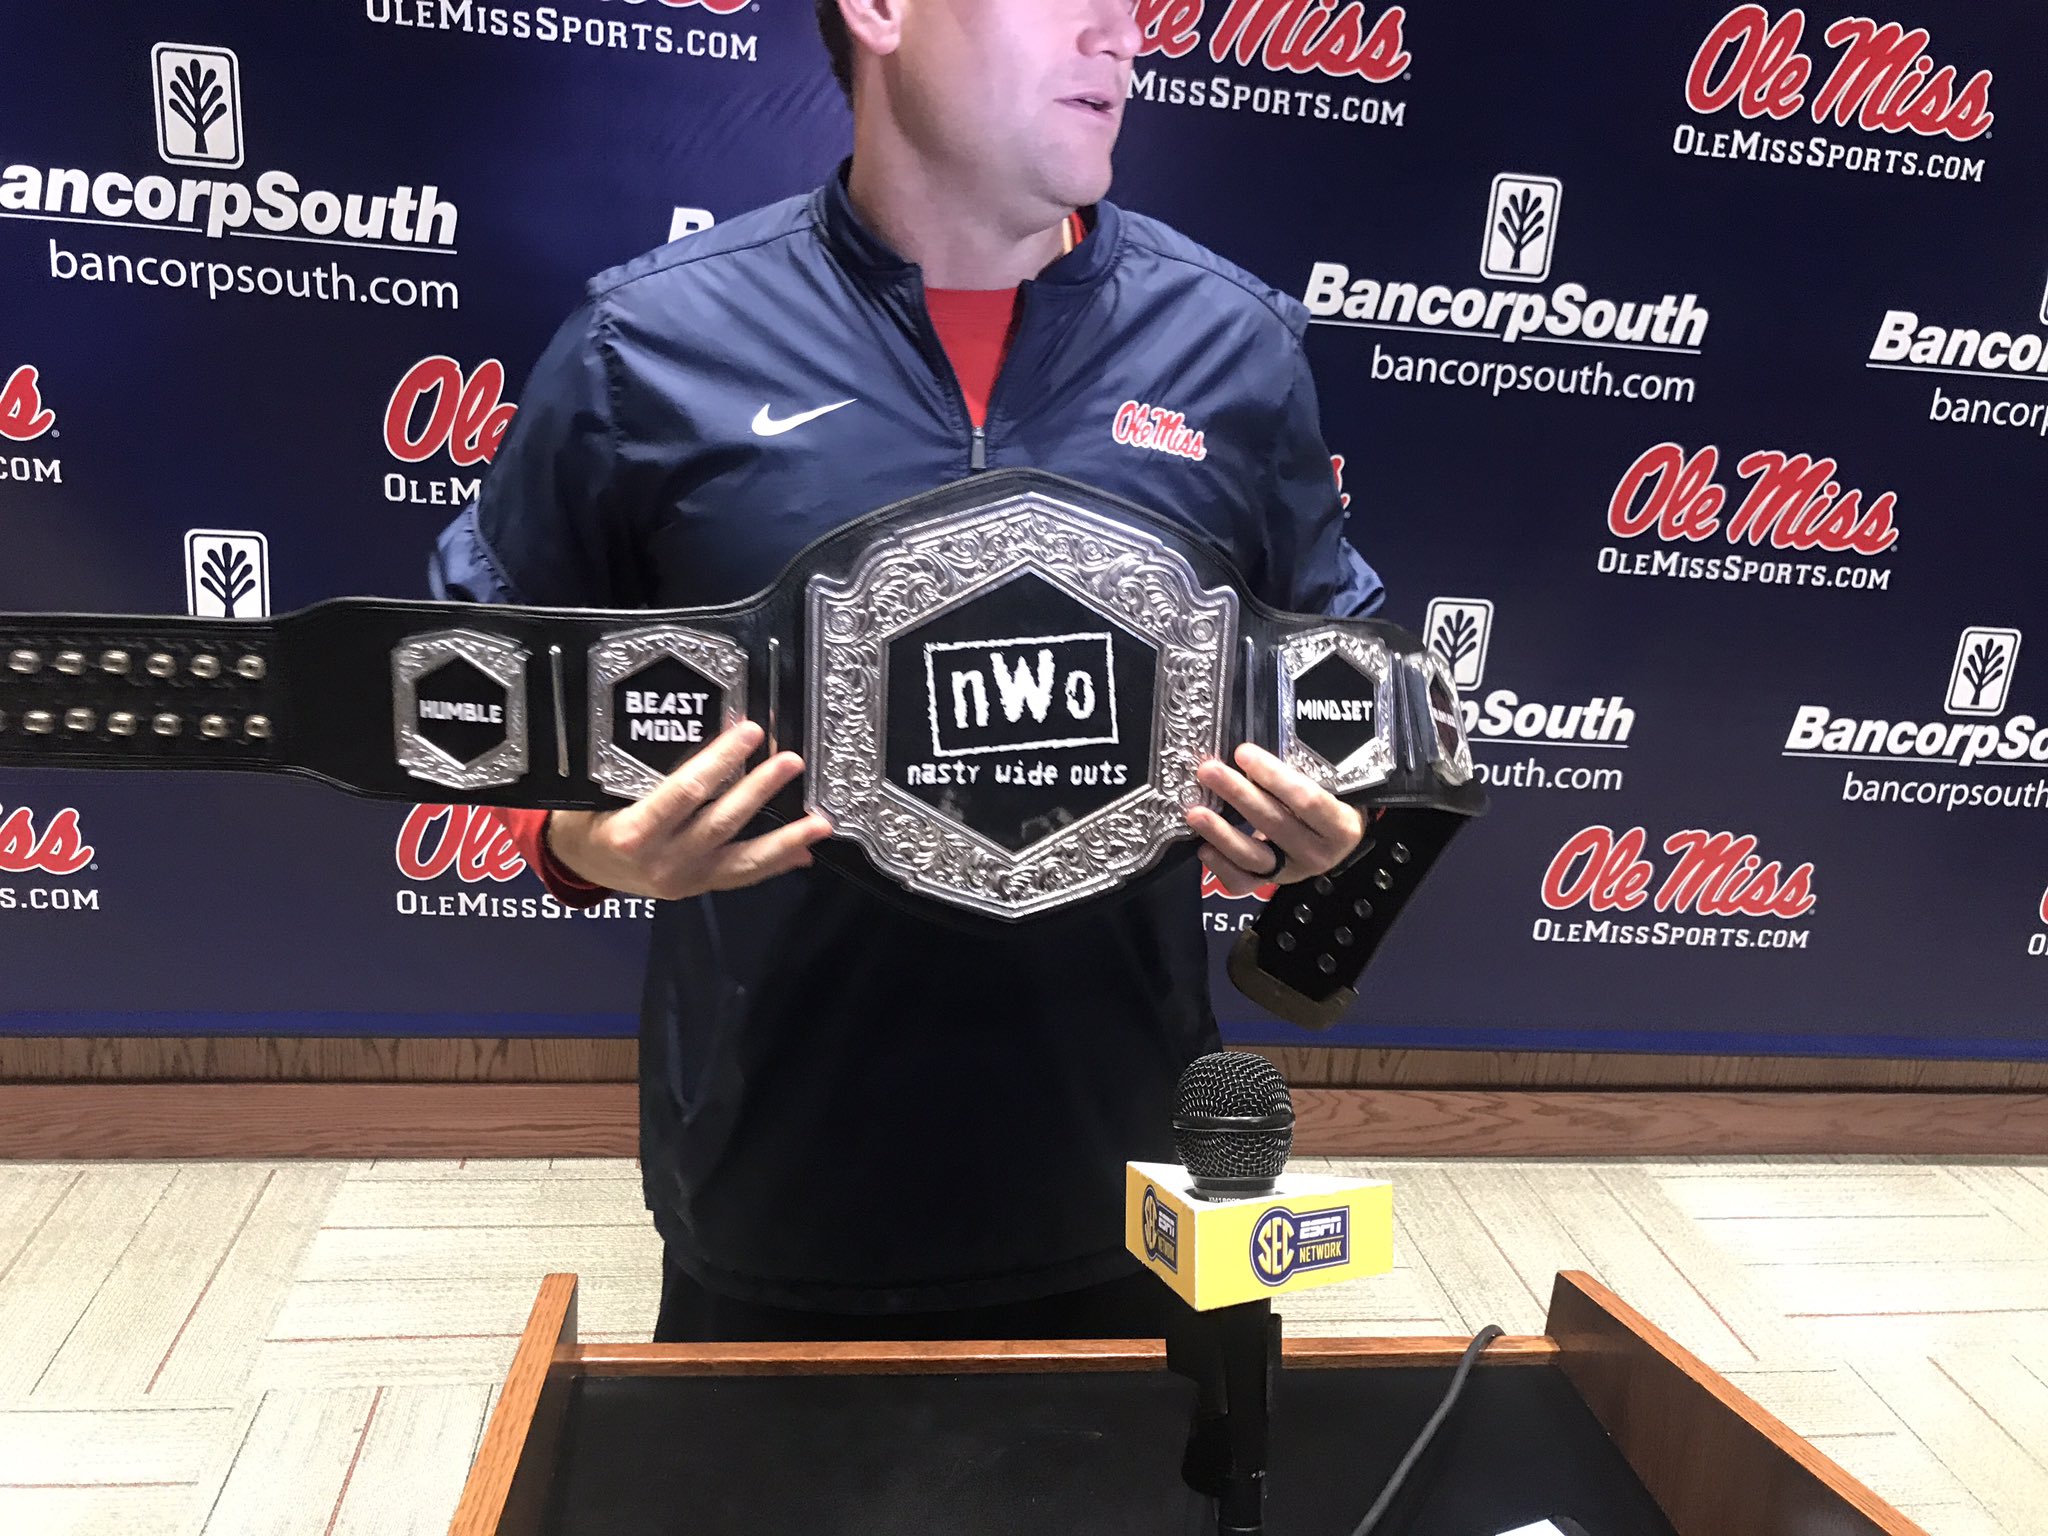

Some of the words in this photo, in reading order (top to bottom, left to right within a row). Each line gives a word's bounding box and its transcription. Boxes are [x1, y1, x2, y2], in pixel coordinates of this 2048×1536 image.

[1126, 69, 1406, 127] MISSSPORTS.COM
[1685, 4, 1812, 120] Ole
[1812, 17, 1994, 142] Miss
[0, 164, 458, 245] ancorpSouth
[49, 239, 459, 310] bancorpsouth.com
[1303, 261, 1710, 347] BancorpSouth
[1370, 344, 1696, 403] bancorpsouth.com
[384, 355, 519, 467] Ole
[1112, 400, 1154, 448] Ole
[1150, 407, 1207, 461] Miss
[1608, 442, 1725, 542] Ole
[1726, 450, 1899, 555] Miss
[419, 699, 503, 724] HUMBLE
[625, 691, 709, 716] BEAST
[951, 648, 1096, 729] nWo
[1296, 699, 1374, 722] MINDSET
[1459, 689, 1635, 741] pSouth
[630, 718, 704, 743] MODE
[1784, 705, 2048, 766] BancorpSo
[907, 760, 981, 786] nasty
[995, 760, 1058, 786] wide
[1070, 760, 1128, 786] outs
[1474, 758, 1623, 791] outh.com
[1842, 771, 2048, 811] bancorpsouth
[396, 804, 527, 883] Ole
[1541, 825, 1653, 911] Ole
[1654, 829, 1817, 919] Miss
[1258, 1217, 1294, 1275] SEC
[1300, 1216, 1342, 1240] ESPN
[1300, 1240, 1342, 1264] NETWORK
